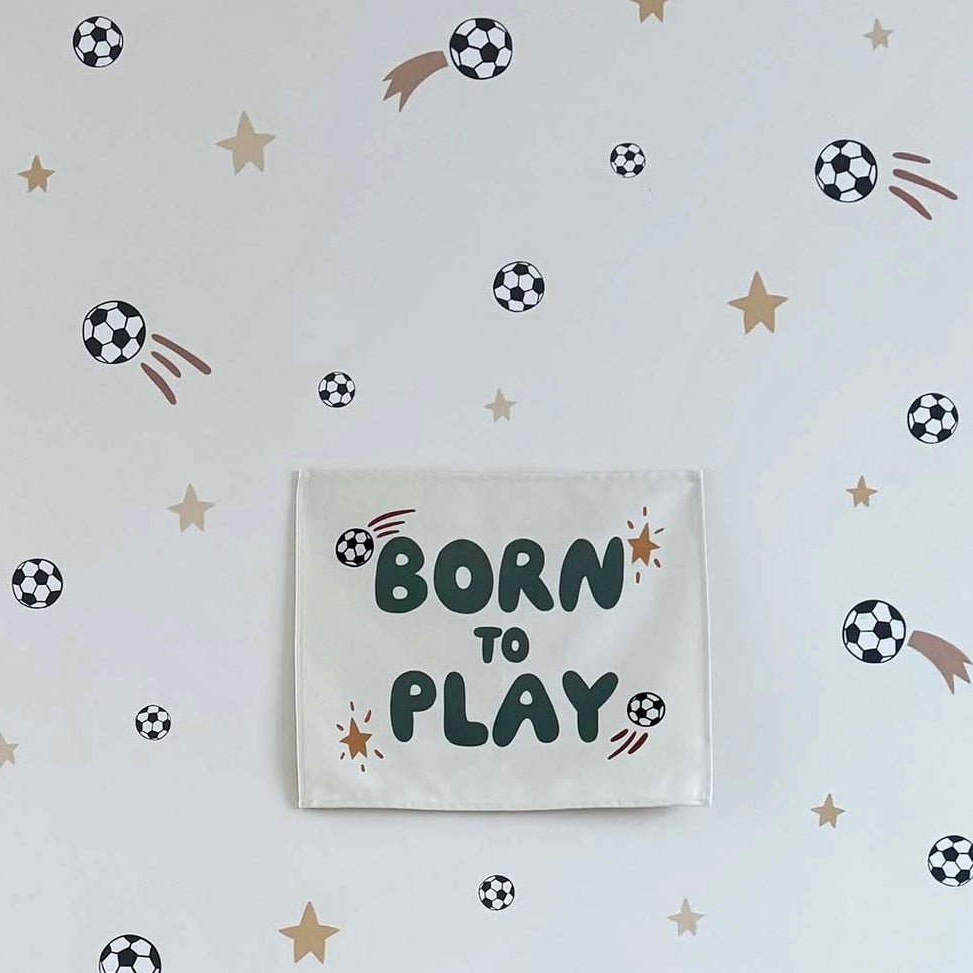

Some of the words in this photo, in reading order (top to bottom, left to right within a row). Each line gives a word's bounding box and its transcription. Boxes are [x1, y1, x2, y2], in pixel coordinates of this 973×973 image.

[375, 536, 624, 614] BORN
[474, 626, 529, 663] TO
[390, 670, 619, 747] PLAY
